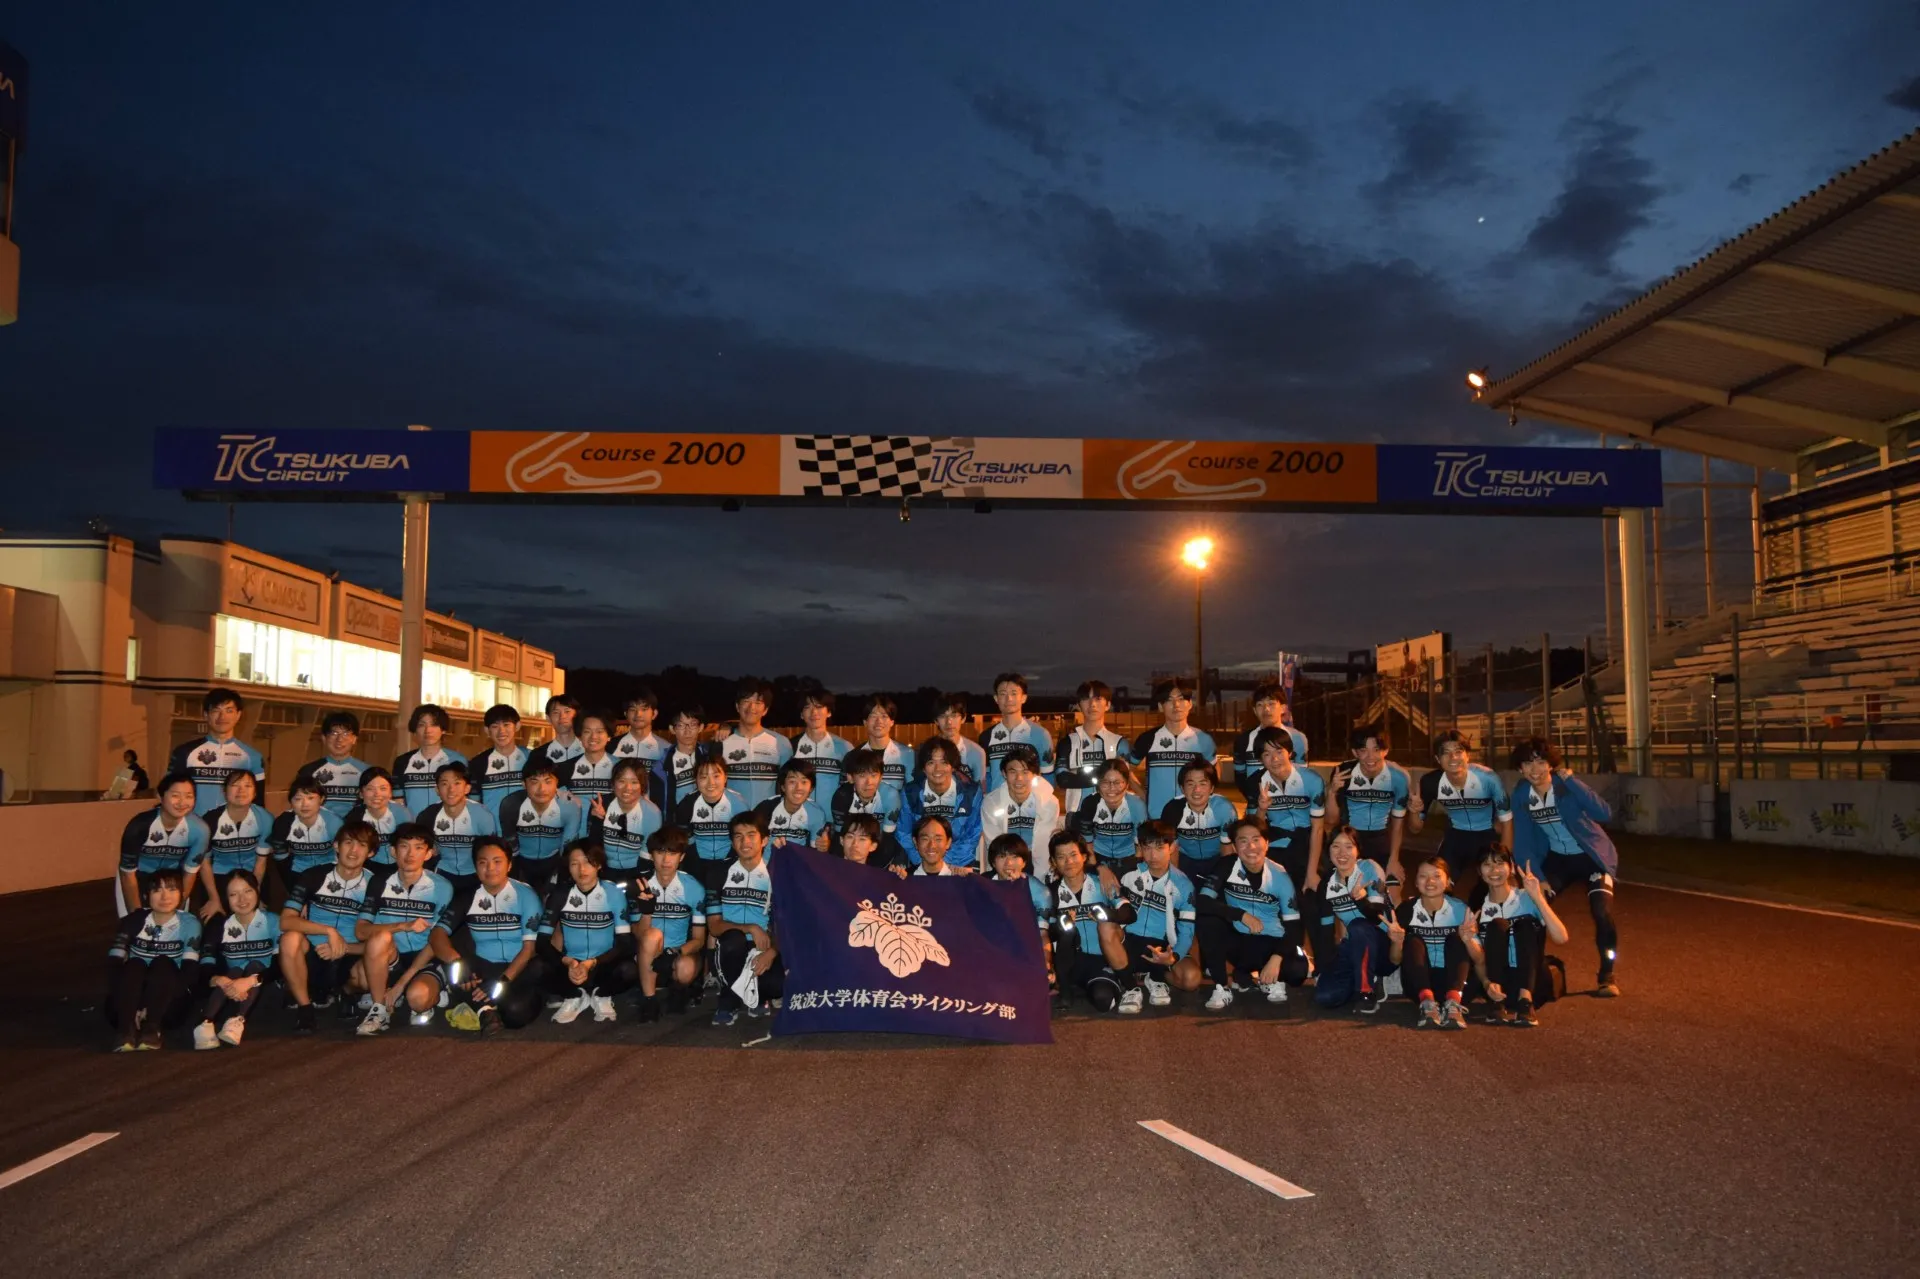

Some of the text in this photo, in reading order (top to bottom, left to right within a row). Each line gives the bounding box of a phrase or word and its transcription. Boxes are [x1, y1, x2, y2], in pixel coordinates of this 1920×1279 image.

[580, 442, 745, 466] course 2000
[272, 453, 410, 470] TSUKUBA
[1187, 450, 1344, 474] course 2000
[972, 462, 1072, 475] TSUKUBA
[1485, 469, 1609, 486] TSUKUBA
[1156, 752, 1196, 760] TSUKUBA
[730, 763, 772, 771] TSUKUBA
[195, 768, 231, 777] TSUKU
[573, 780, 609, 788] TSUKUB
[725, 889, 768, 899] TSUKUBA
[385, 900, 431, 910] TSUKUBA
[564, 912, 610, 921] TSUKUBA
[789, 988, 1017, 1020] 筑波大学体育会サイクリング部
